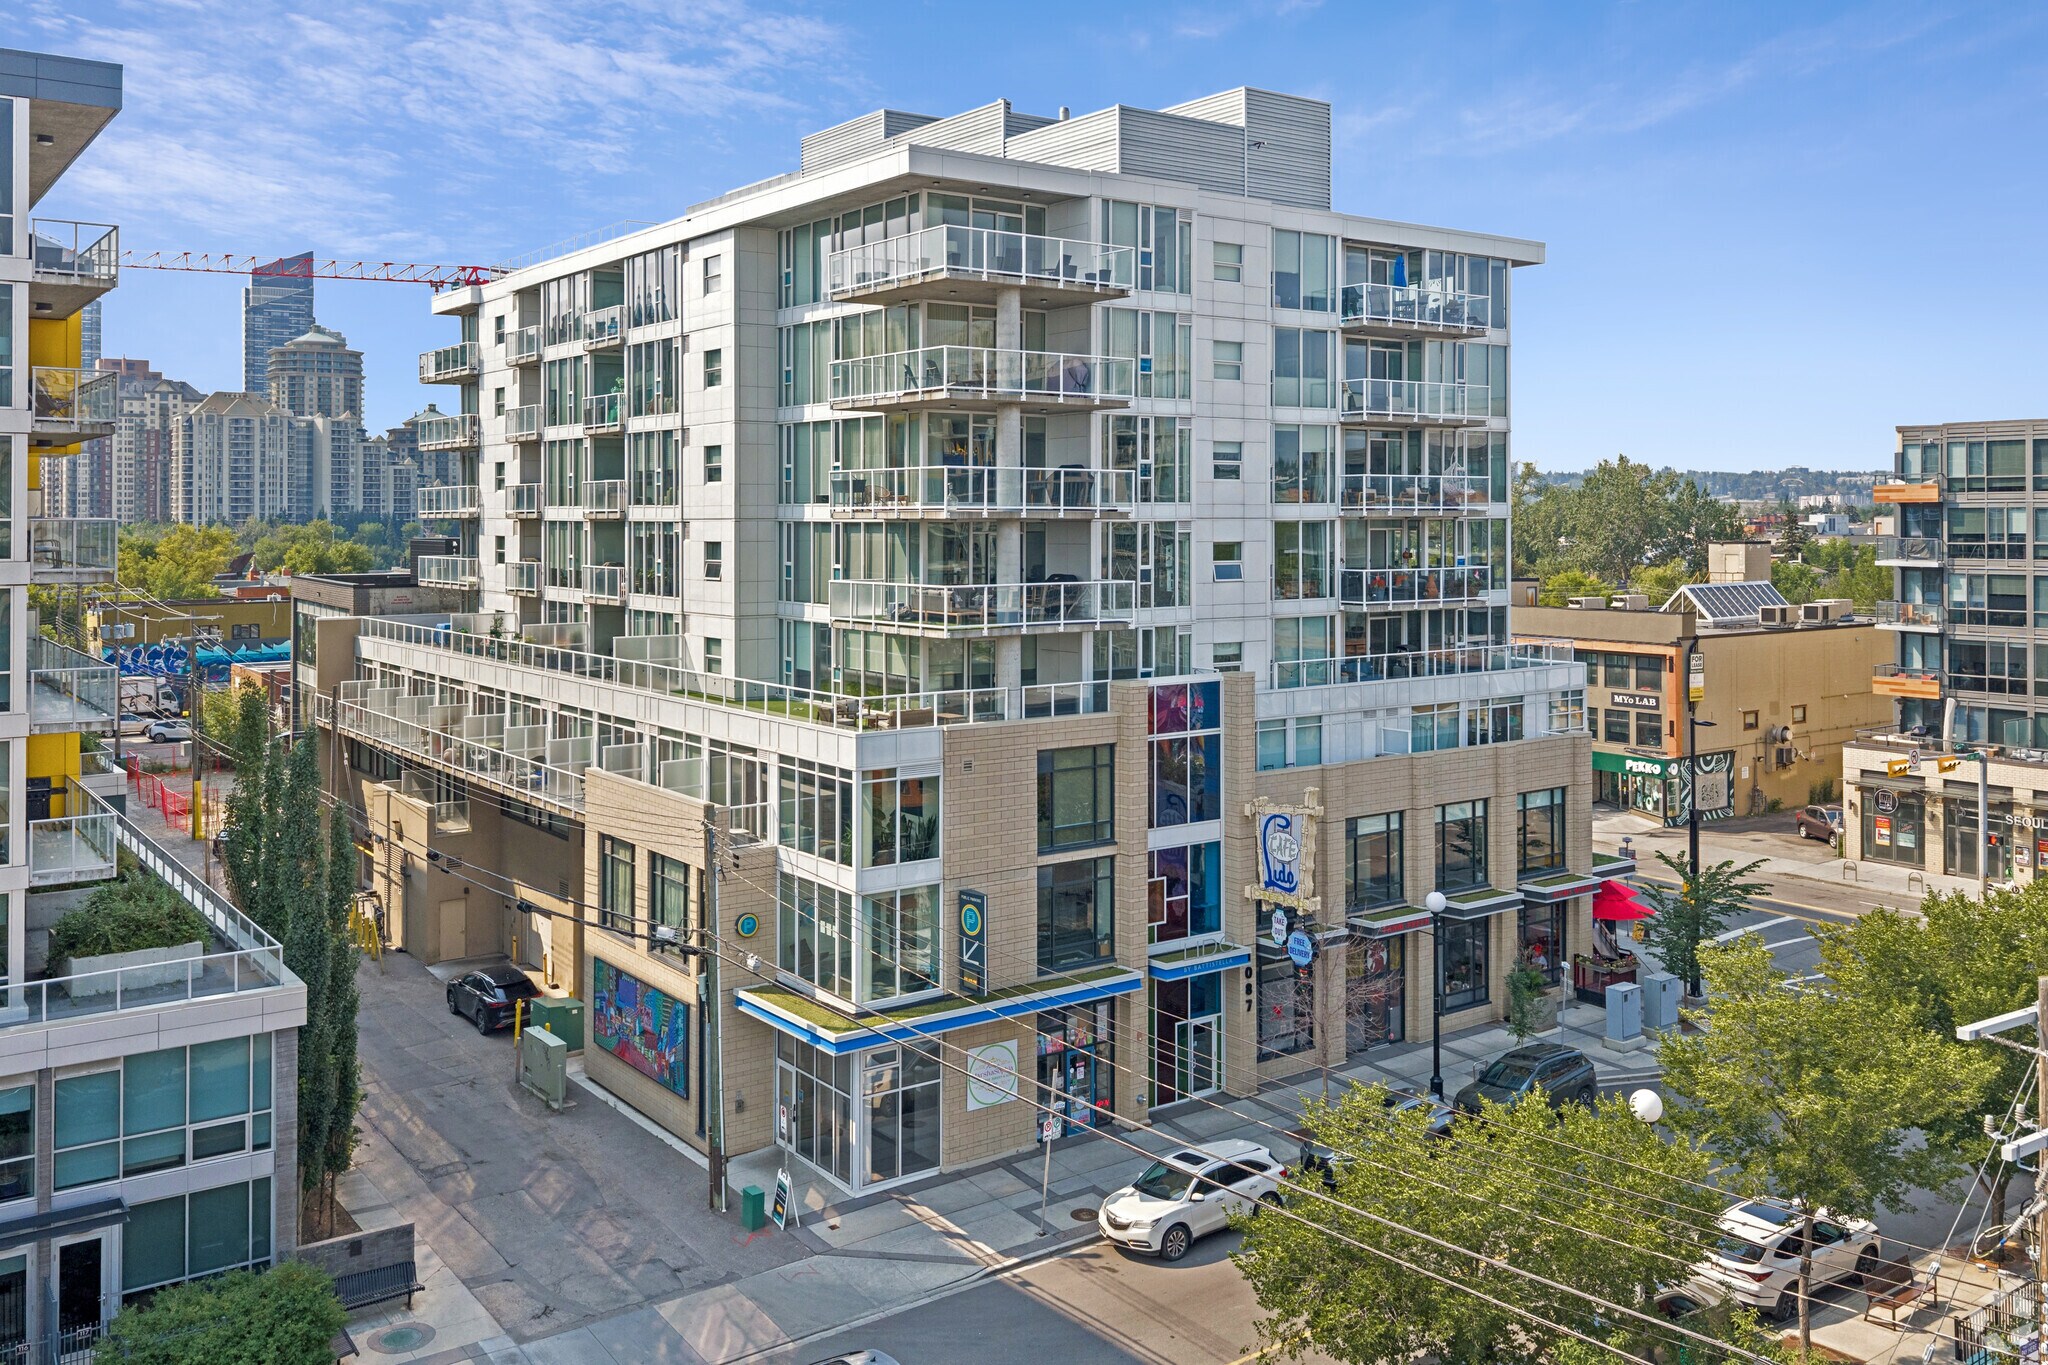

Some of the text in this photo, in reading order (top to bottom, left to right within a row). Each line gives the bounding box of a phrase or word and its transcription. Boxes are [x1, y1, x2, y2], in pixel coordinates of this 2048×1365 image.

[1691, 655, 1703, 663] FOR
[1635, 697, 1656, 706] LAB
[1625, 759, 1661, 775] PEKKO
[2005, 814, 2048, 830] SEOUL
[1262, 814, 1299, 893] Lido
[966, 910, 976, 929] P
[1274, 916, 1285, 926] TAKE
[1293, 937, 1305, 947] FREE
[1289, 946, 1311, 959] DELIVERY
